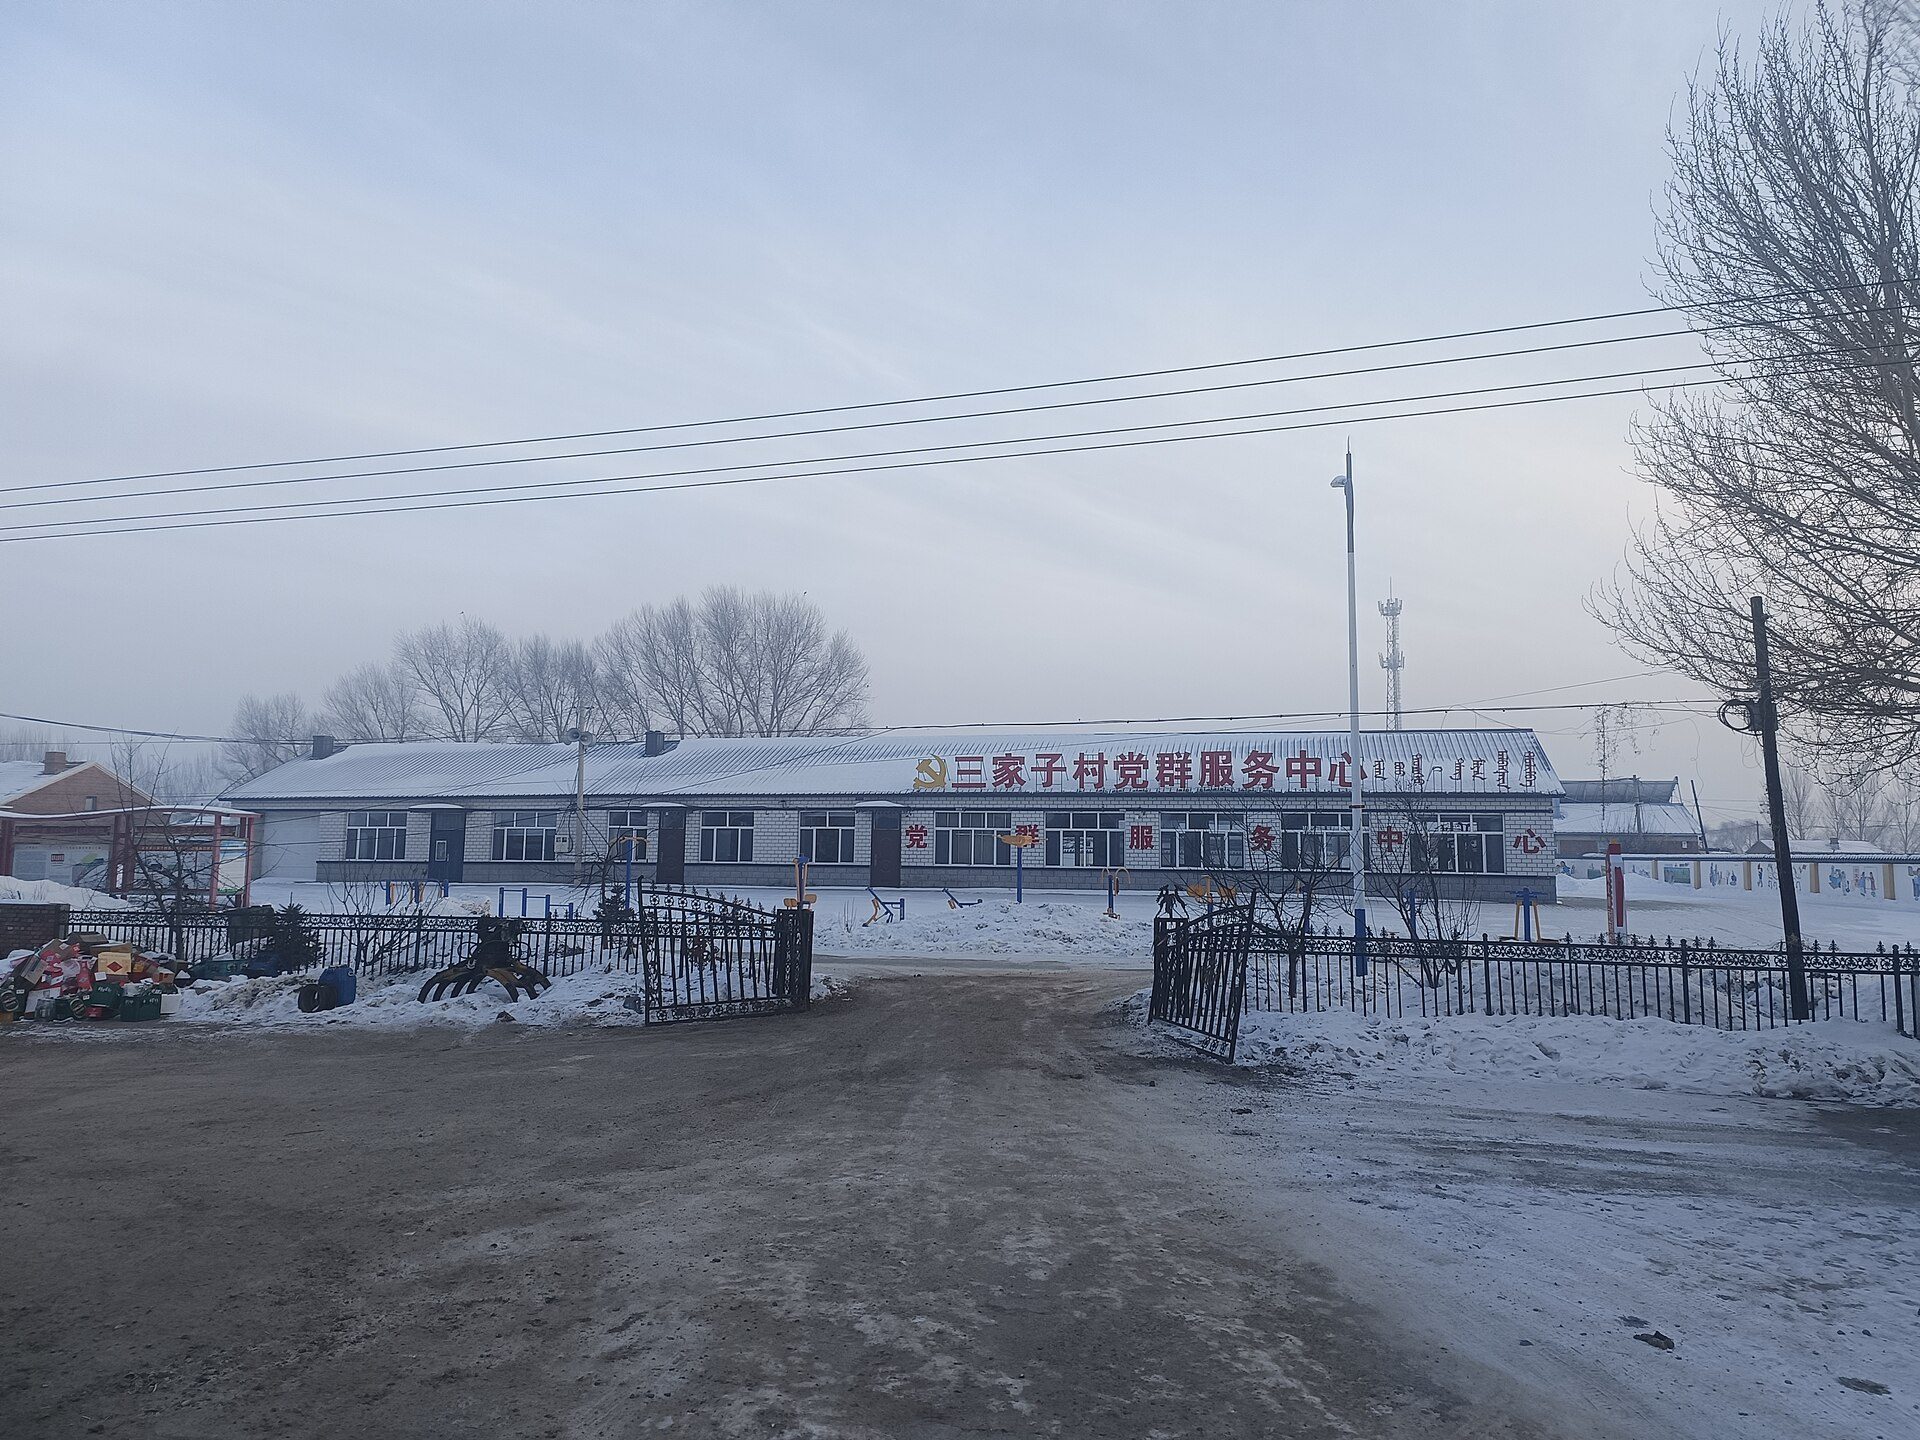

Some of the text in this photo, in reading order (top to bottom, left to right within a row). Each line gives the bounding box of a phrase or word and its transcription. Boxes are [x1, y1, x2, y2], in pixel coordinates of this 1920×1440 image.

[951, 750, 1368, 790] 三家子村党群服务中心
